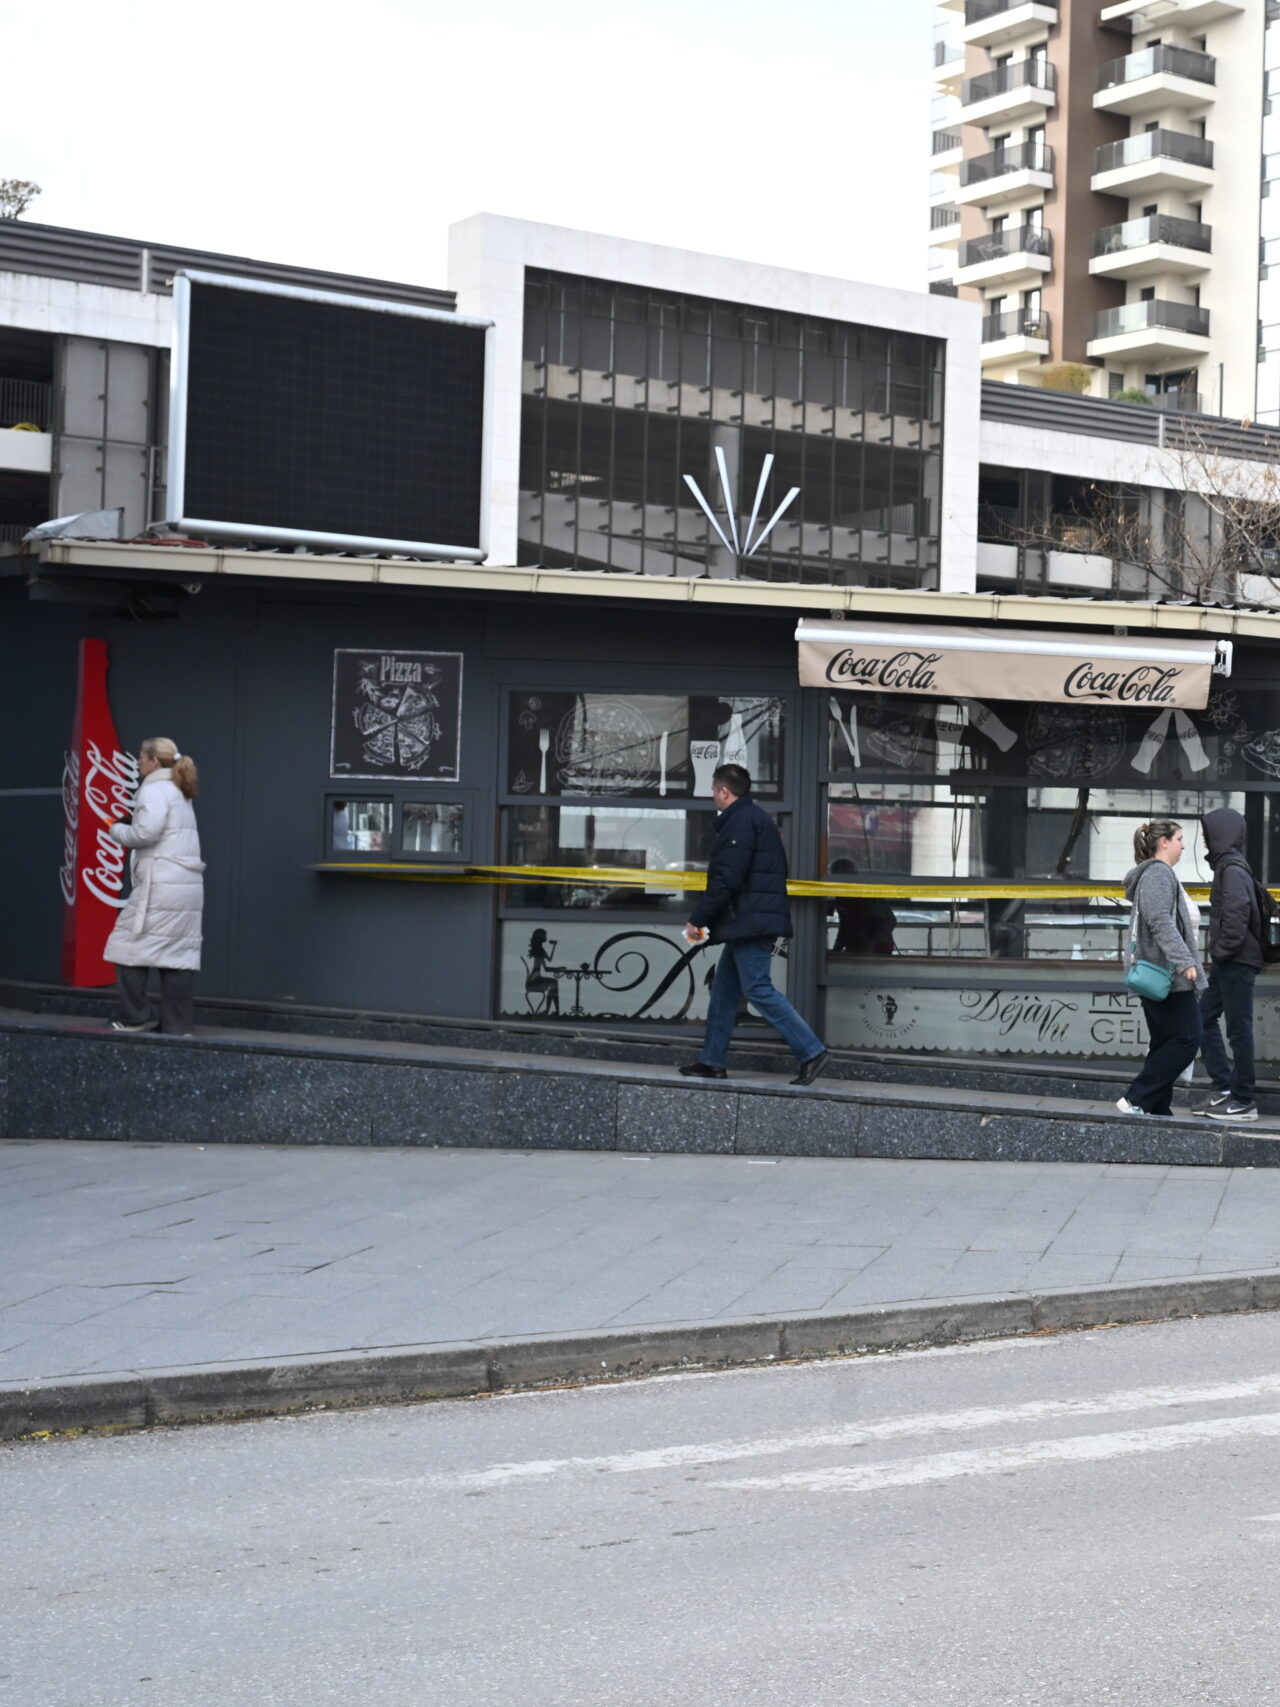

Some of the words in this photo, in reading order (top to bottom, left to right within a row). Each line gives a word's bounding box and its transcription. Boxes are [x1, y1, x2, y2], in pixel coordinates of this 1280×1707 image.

[380, 655, 422, 683] Pizza
[825, 648, 943, 690] Coca-Cola
[1063, 662, 1184, 702] Coca-Cola
[1090, 1018, 1149, 1045] GEL
